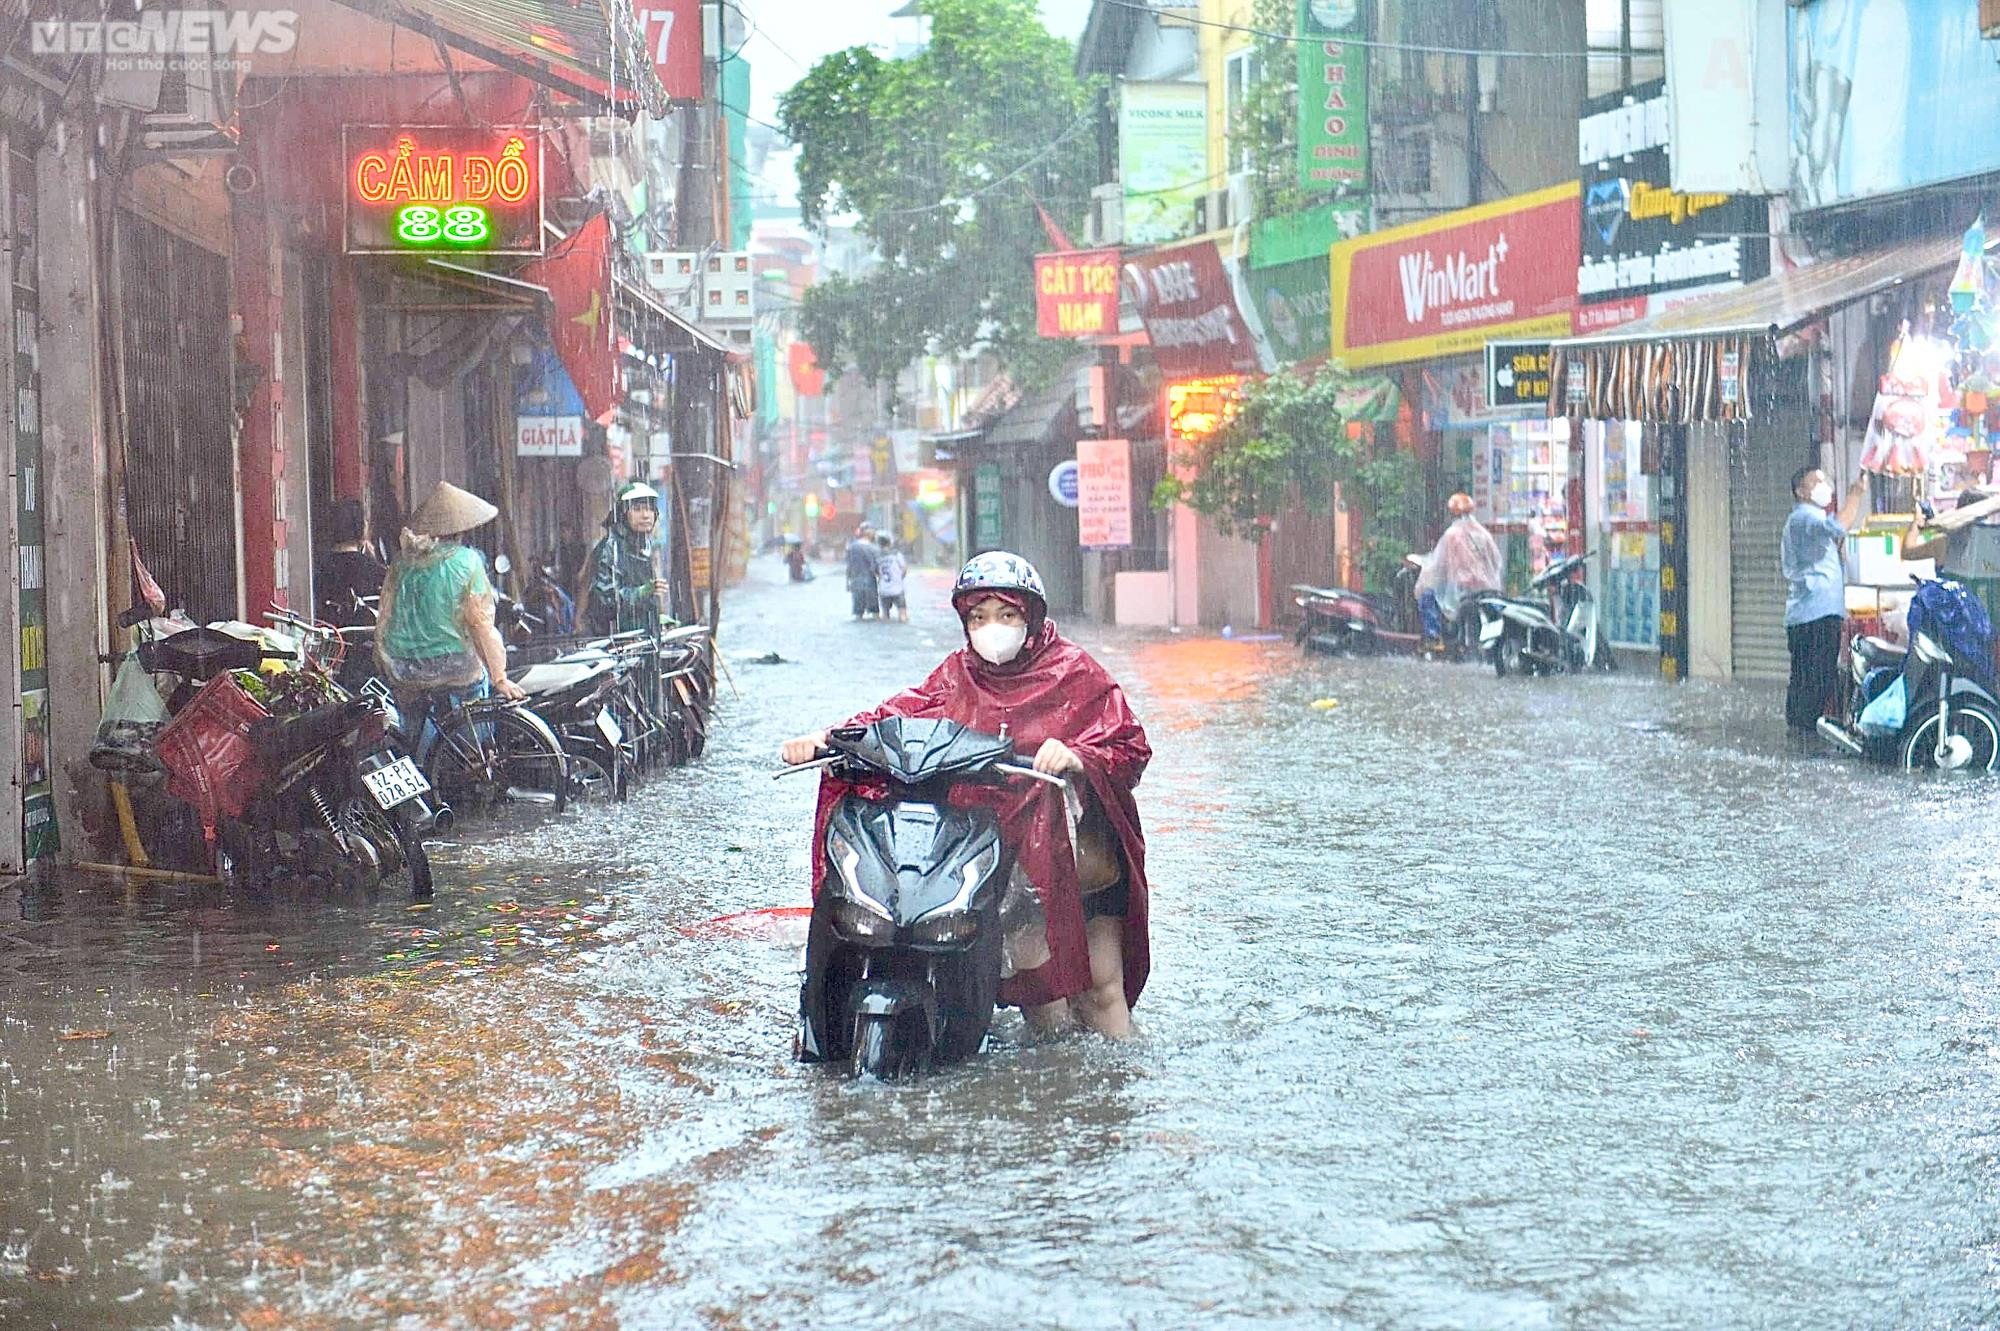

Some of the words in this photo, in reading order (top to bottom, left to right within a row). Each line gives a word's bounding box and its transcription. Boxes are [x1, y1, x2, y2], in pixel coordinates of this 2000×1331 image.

[1176, 109, 1204, 119] MILK
[358, 138, 453, 201] CẦM
[463, 136, 529, 202] ĐỒ
[399, 206, 487, 241] 88
[1057, 302, 1103, 332] NAM
[378, 775, 426, 806] 028.54
